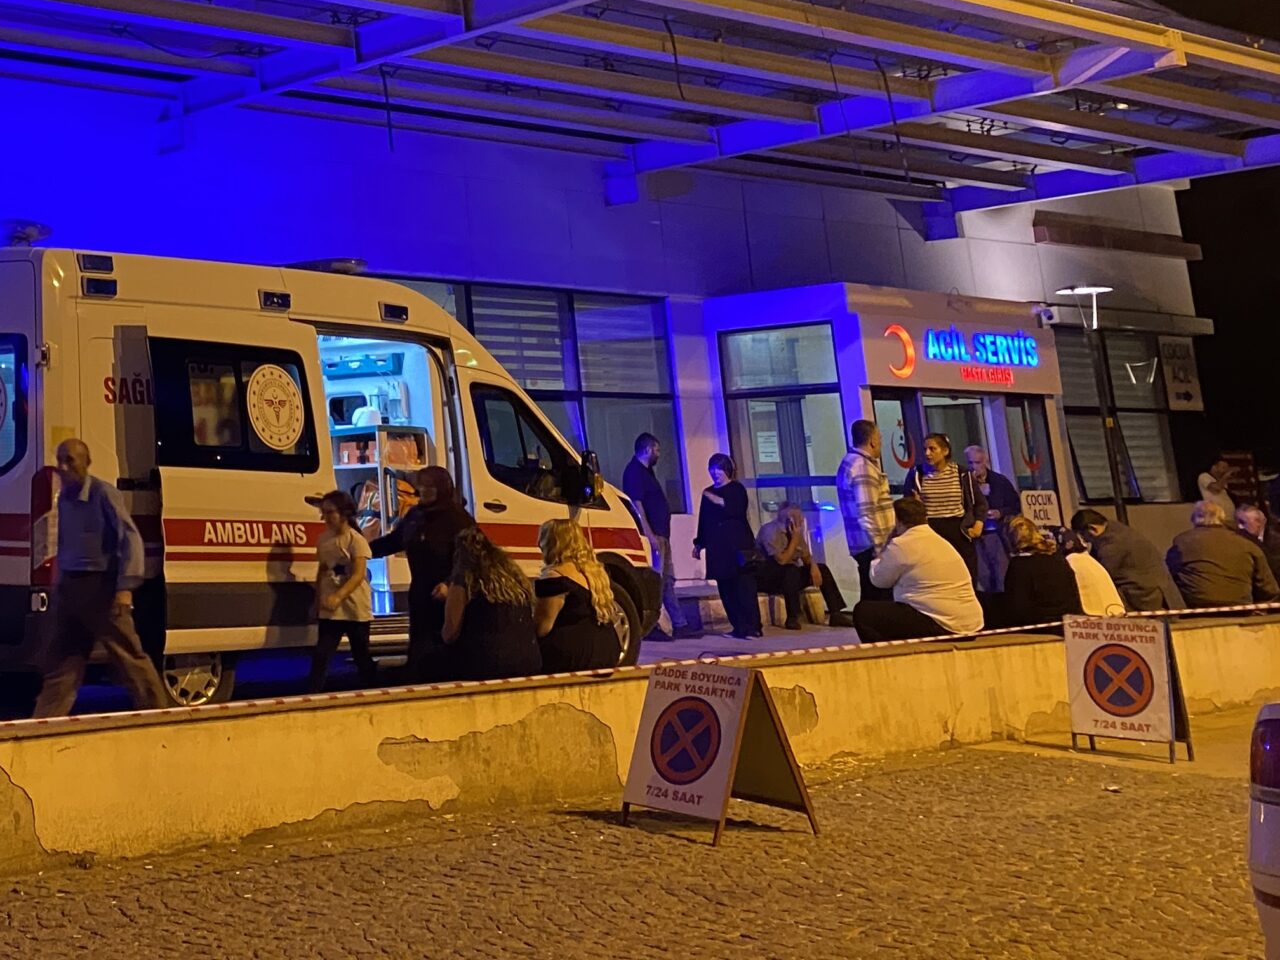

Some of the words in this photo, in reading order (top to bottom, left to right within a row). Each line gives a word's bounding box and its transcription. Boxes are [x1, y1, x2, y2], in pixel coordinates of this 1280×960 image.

[926, 325, 971, 363] ACİL
[973, 330, 1039, 368] SERVİS
[1026, 494, 1054, 509] ÇOCUK
[1033, 507, 1051, 521] ACİL
[203, 521, 307, 545] AMBULANS
[1068, 619, 1104, 631] CADDE
[1106, 622, 1159, 634] BOYUNCA
[1071, 631, 1100, 641] PARK
[1102, 632, 1157, 644] YASAKTIR
[654, 667, 689, 681] CADDE
[690, 671, 742, 687] BOYUNCA
[654, 680, 681, 693] PARK
[683, 682, 737, 700] YASAKTIR
[1092, 719, 1118, 730] 7/24
[1120, 720, 1152, 734] SAAT
[646, 784, 670, 799] 7/24
[671, 790, 704, 806] SAAT
